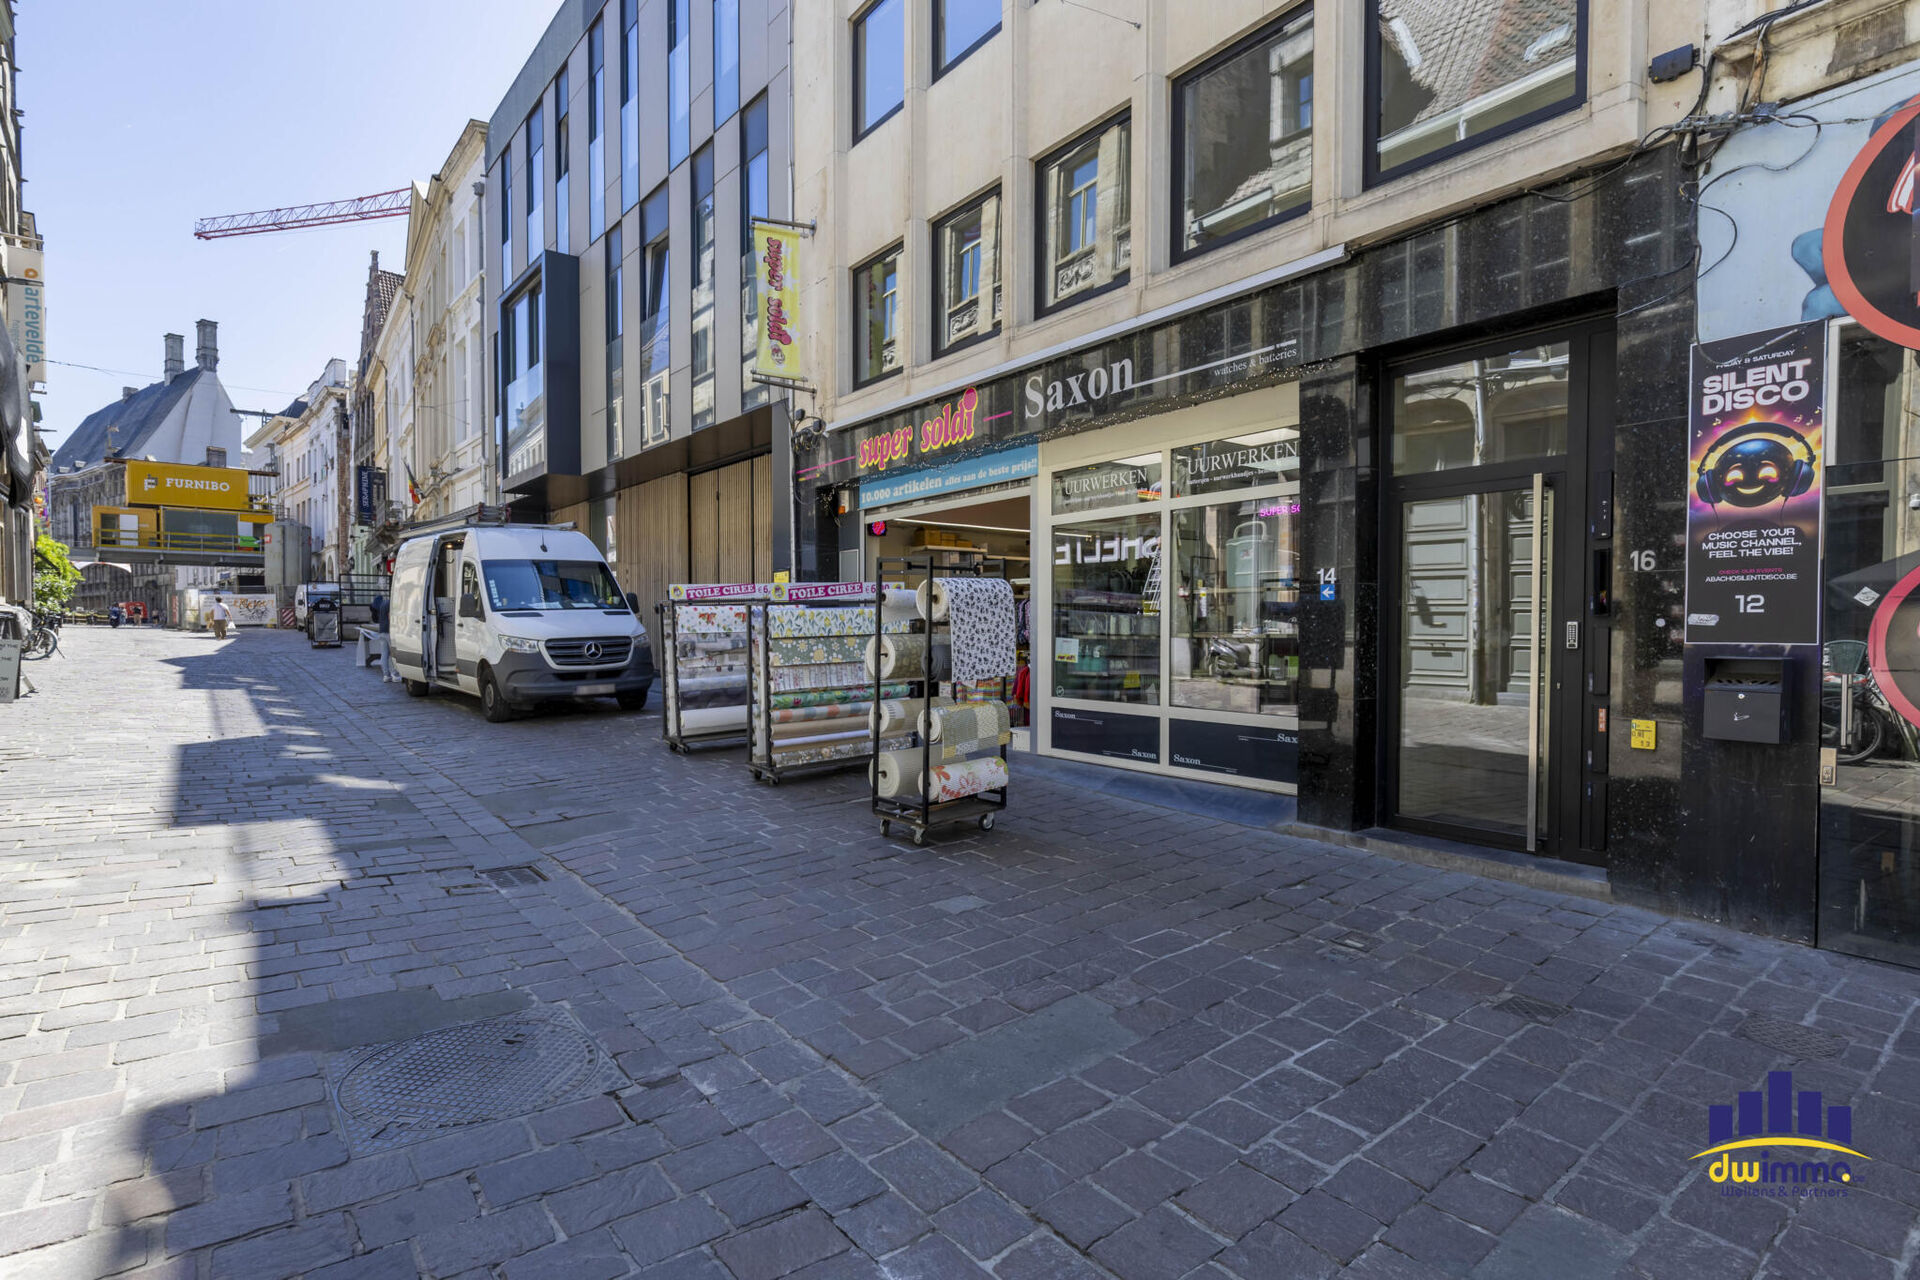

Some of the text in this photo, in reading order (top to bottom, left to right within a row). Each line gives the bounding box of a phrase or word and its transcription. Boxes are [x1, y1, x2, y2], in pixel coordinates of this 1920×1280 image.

[763, 236, 792, 345] super soldi
[24, 286, 45, 364] artevelde
[1214, 347, 1297, 377] watches & batteries
[1752, 349, 1796, 363] SATURDAY
[1703, 358, 1812, 395] SILENT
[1024, 356, 1134, 420] Saxon
[1702, 380, 1810, 416] DISCO
[858, 386, 979, 471] super soldi
[1187, 441, 1299, 475] UURWERKEN
[166, 477, 231, 492] FURNIBO
[861, 488, 891, 504] 10.000
[893, 476, 943, 497] artikelen
[963, 473, 976, 482] aan
[978, 468, 987, 479] de
[988, 465, 1009, 477] beste
[1064, 467, 1149, 496] UURWERKEN
[1260, 505, 1288, 518] SUPER
[1708, 527, 1796, 541] CHOOSE YOUR
[1702, 537, 1802, 551] MUSIC CHANNEL,
[1709, 546, 1794, 559] FEEL THE VIBE!
[1630, 549, 1656, 571] 16
[1316, 567, 1337, 585] 14
[687, 587, 721, 599] TOILE
[789, 587, 826, 600] TOILE
[1734, 594, 1765, 613] 12
[1055, 710, 1076, 719] Saxon
[1131, 748, 1157, 760] Saxon
[1173, 753, 1201, 766] Saxon
